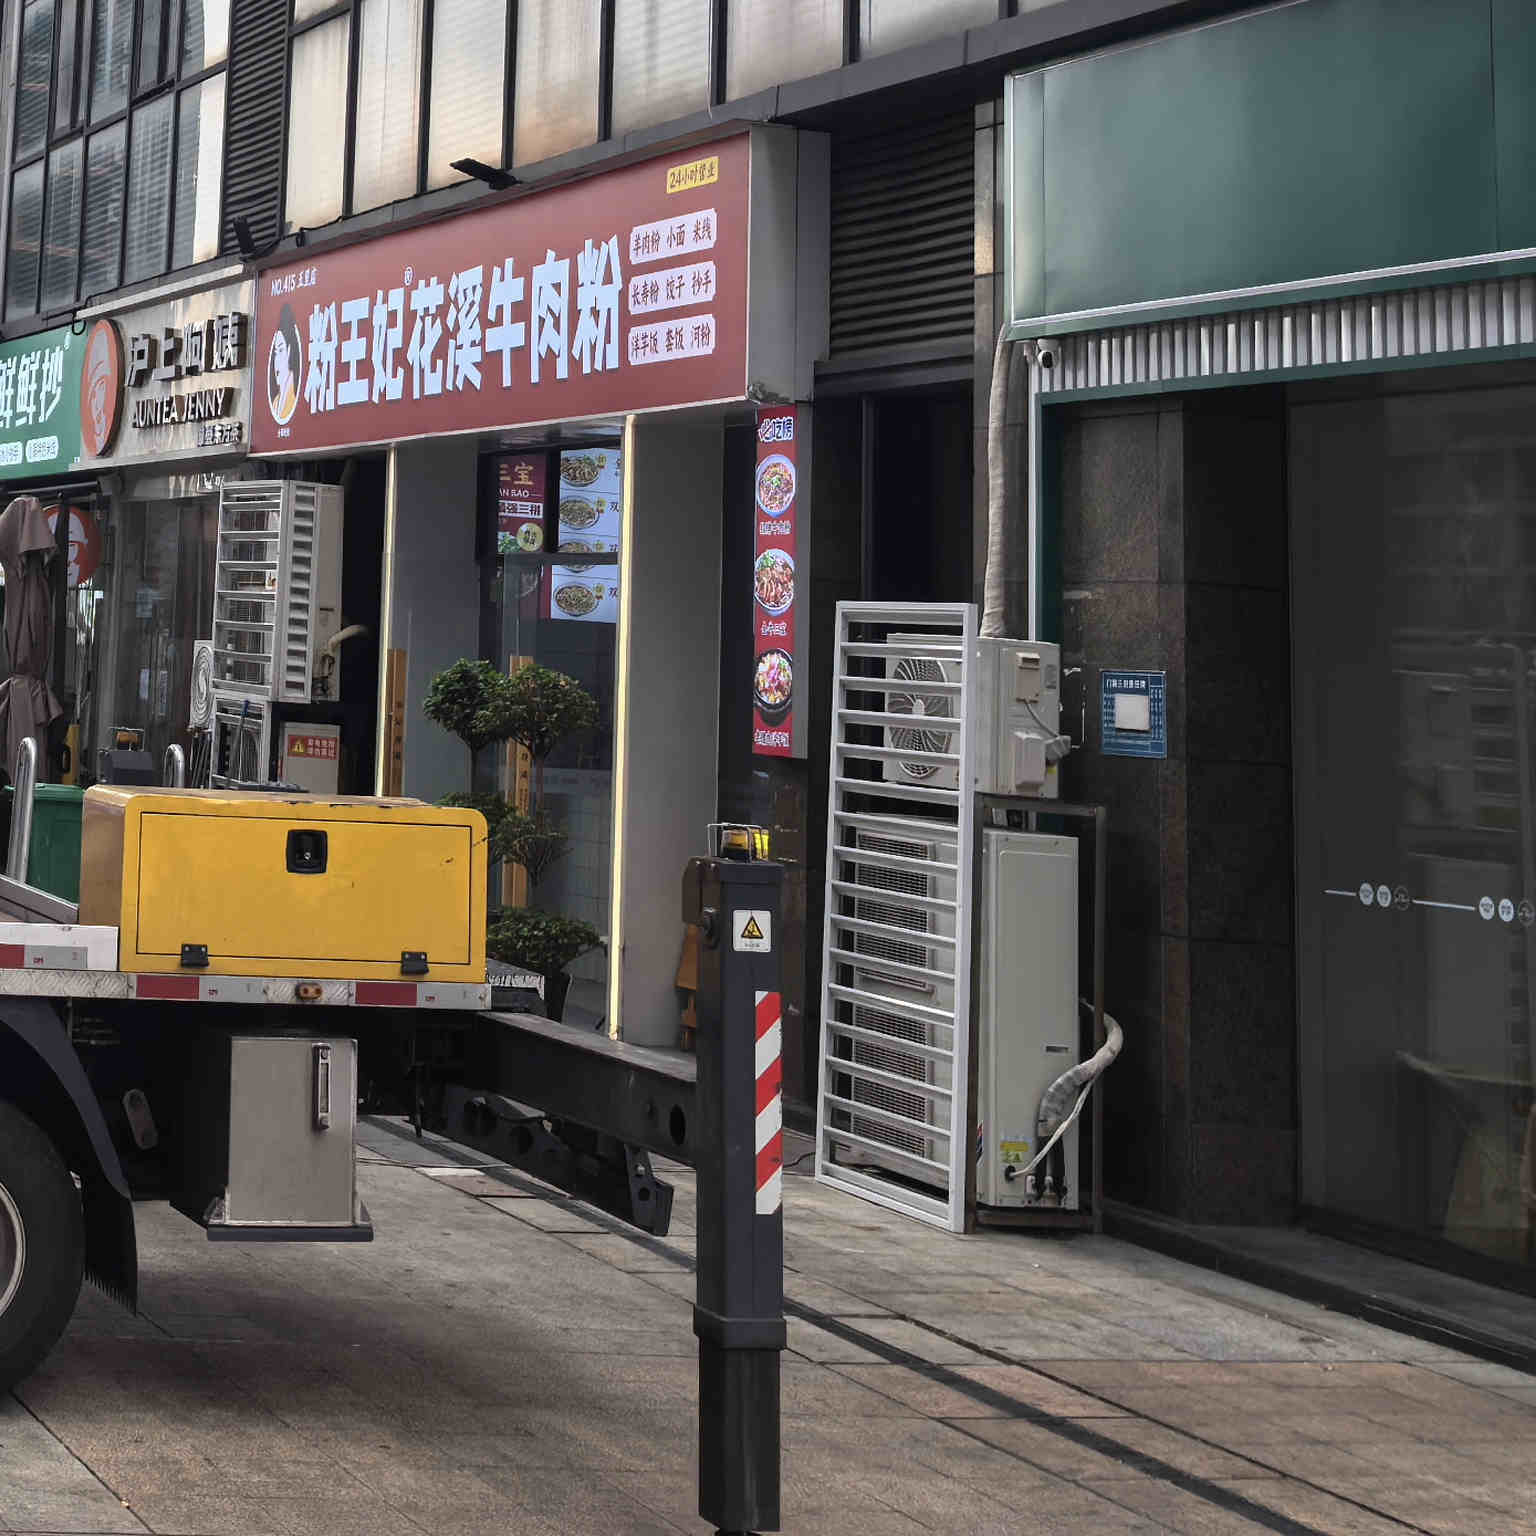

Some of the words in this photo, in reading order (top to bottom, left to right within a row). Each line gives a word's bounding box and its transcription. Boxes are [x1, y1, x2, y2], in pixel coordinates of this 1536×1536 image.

[632, 231, 661, 257] 羊肉粉
[666, 223, 686, 249] 小面
[692, 217, 712, 244] 米线
[631, 281, 660, 307] 长寿粉
[666, 274, 686, 301] 饺子
[691, 269, 712, 296] 抄手
[304, 235, 623, 414] 粉王妃花溪牛肉粉
[631, 330, 659, 360] 洋芋饭
[665, 327, 685, 353] 套饭
[691, 322, 711, 350] 河粉
[128, 312, 244, 387] 沪上阿姨
[133, 394, 178, 429] AUNTEA
[183, 387, 228, 423] JENNY
[758, 417, 794, 443] 必吃榜
